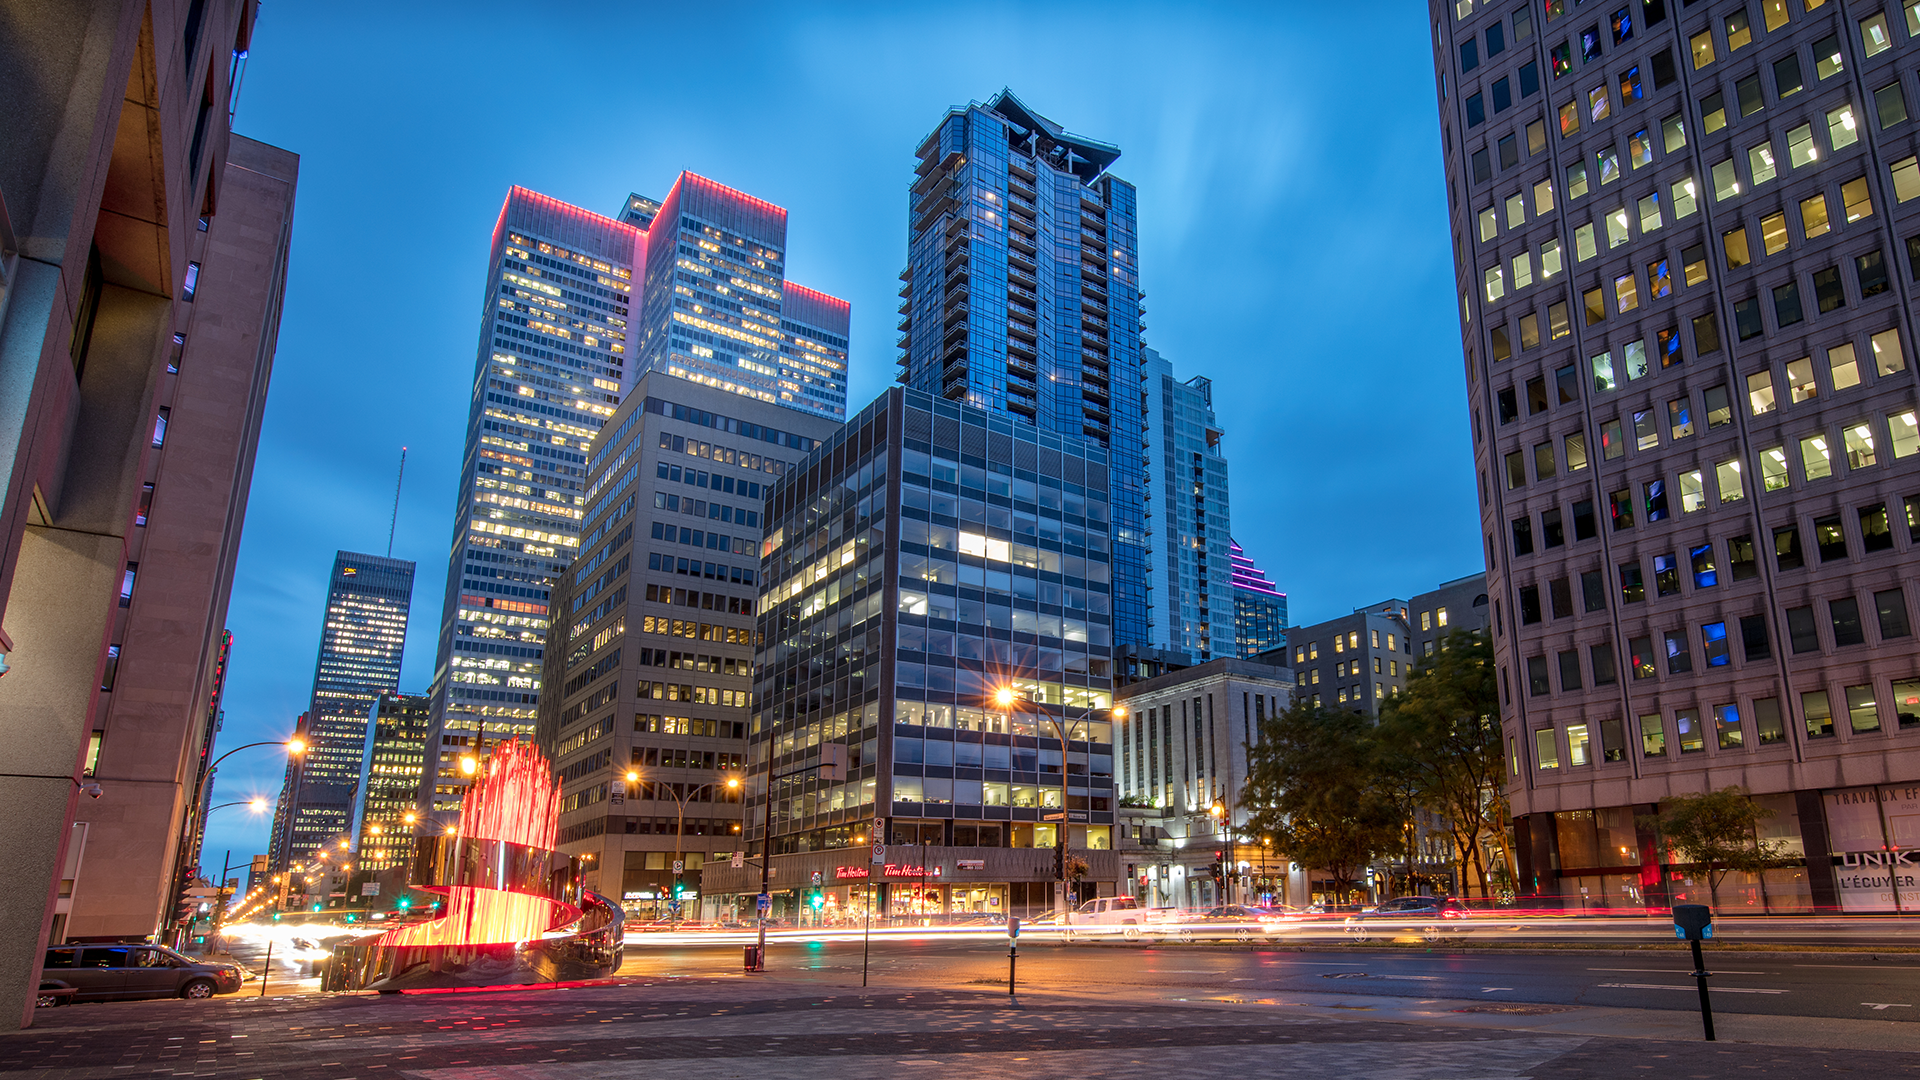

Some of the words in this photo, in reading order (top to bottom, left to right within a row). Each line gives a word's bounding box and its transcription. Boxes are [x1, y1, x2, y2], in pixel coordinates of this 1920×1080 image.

[1834, 790, 1898, 805] TRAVAUX
[1842, 849, 1920, 867] UNIK
[836, 866, 847, 879] Tim
[847, 866, 869, 878] Hortons
[884, 864, 901, 877] Tim
[1840, 874, 1915, 889] L'ÉCUYER
